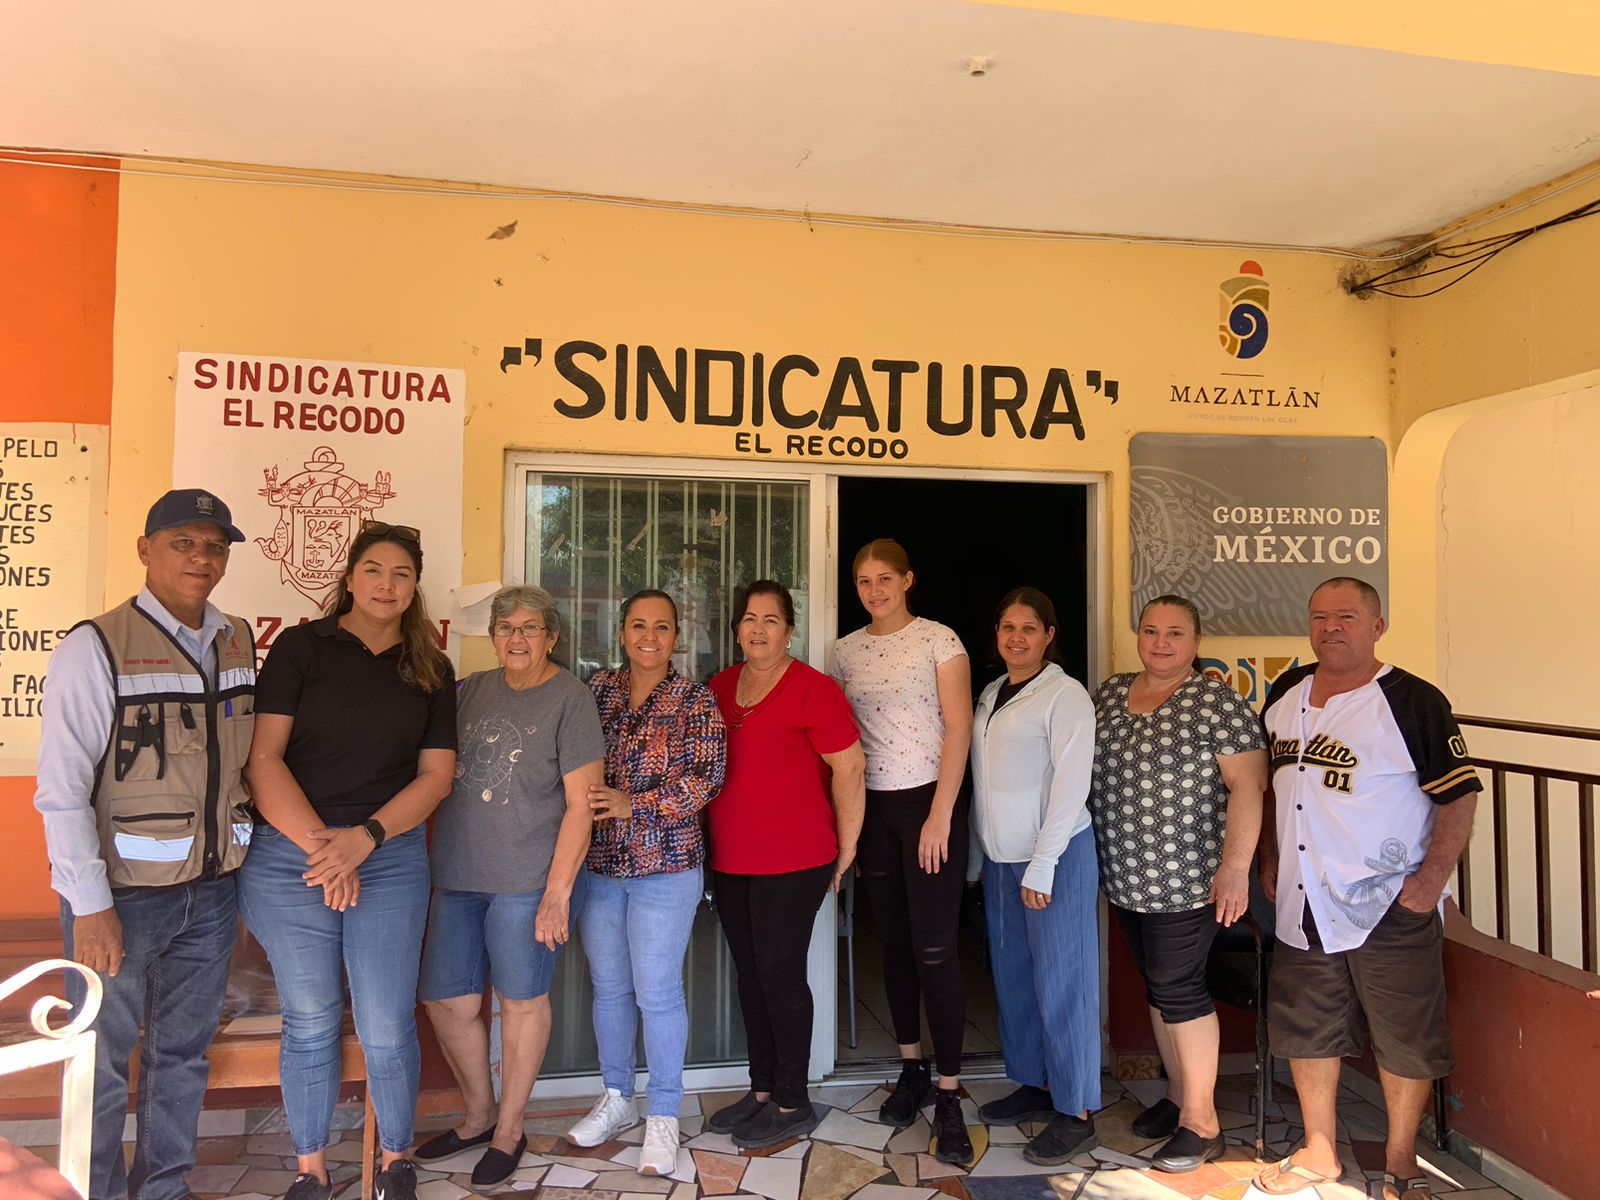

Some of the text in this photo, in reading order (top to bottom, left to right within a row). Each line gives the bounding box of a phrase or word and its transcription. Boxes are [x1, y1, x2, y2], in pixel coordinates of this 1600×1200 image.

[194, 359, 452, 403] SINDICATURA
[223, 398, 405, 435] EL RECODO
[4, 437, 58, 458] PELO
[735, 432, 908, 459] EL RECODO
[1213, 506, 1381, 526] GOBIERNO DE
[1213, 525, 1382, 564] MÉXICO
[301, 571, 342, 580] MAZATL
[1323, 769, 1351, 793] 01
